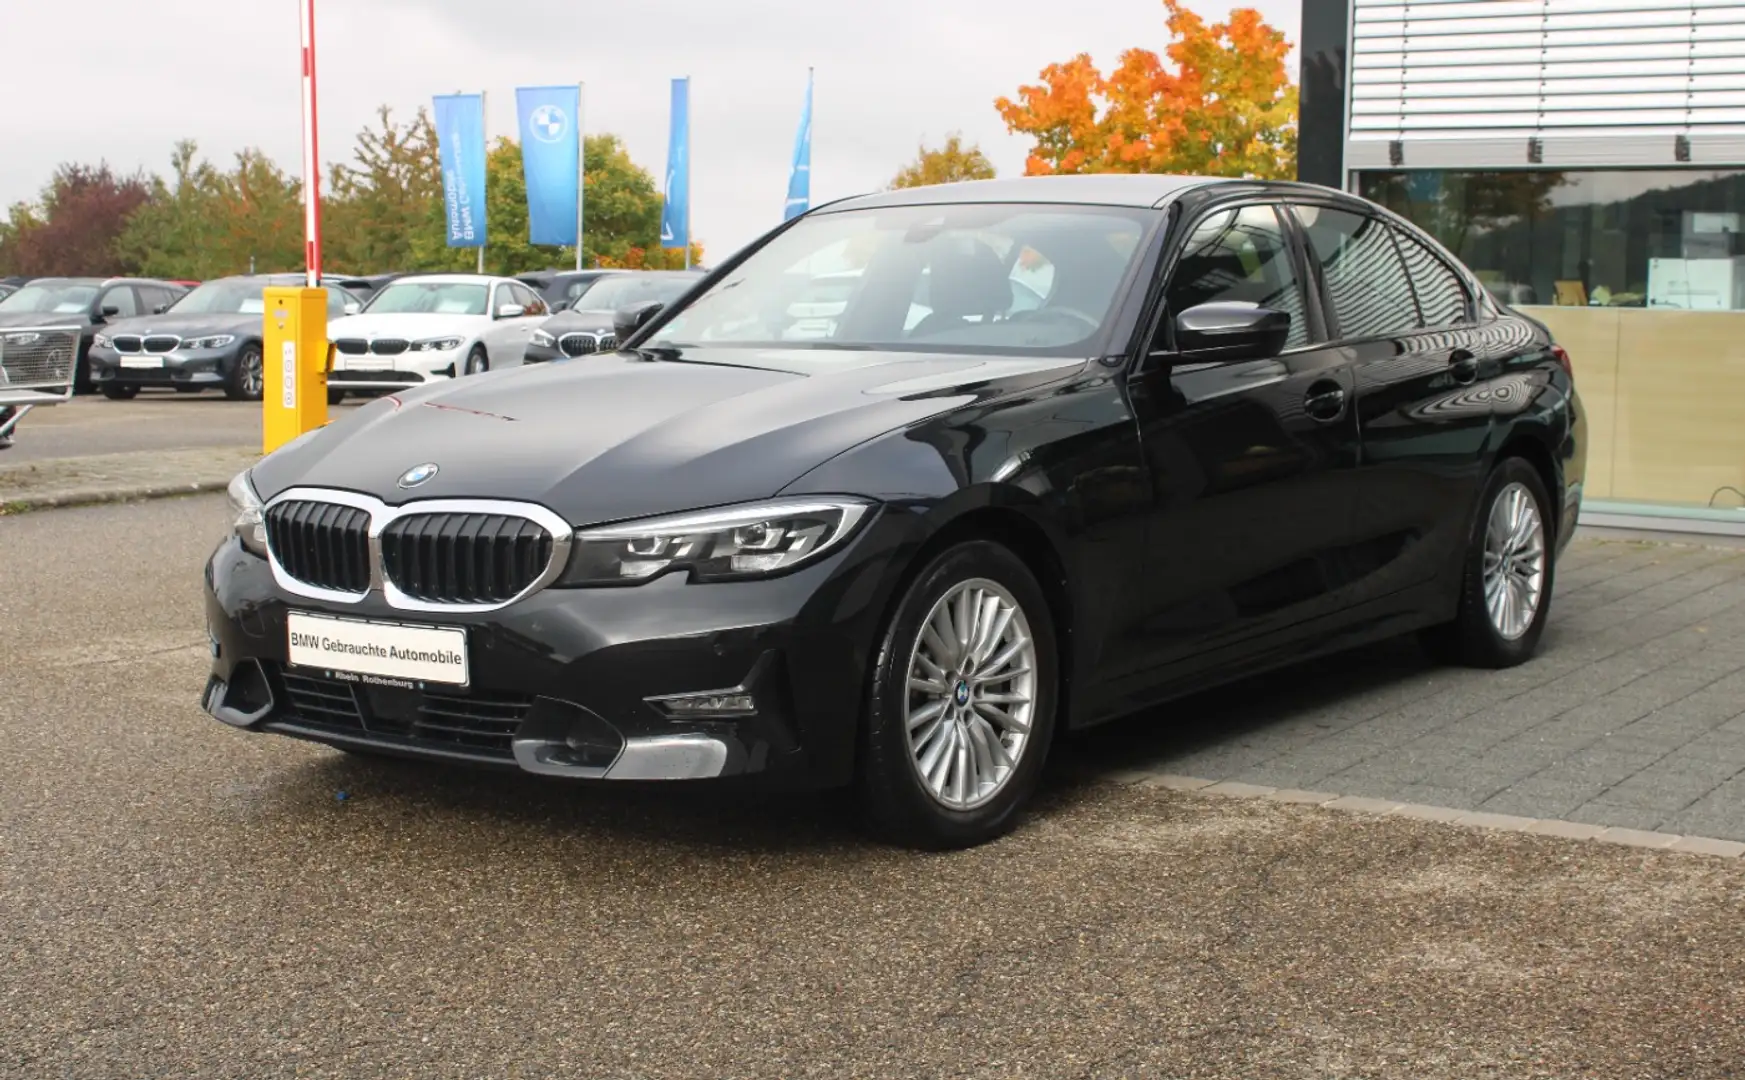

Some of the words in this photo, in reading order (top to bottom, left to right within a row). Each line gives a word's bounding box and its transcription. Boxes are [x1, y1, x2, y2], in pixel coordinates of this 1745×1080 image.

[291, 632, 319, 649] BMW
[322, 637, 387, 658] Gebrauchte
[389, 645, 462, 665] Automobile
[362, 674, 414, 689] Rothenburg
